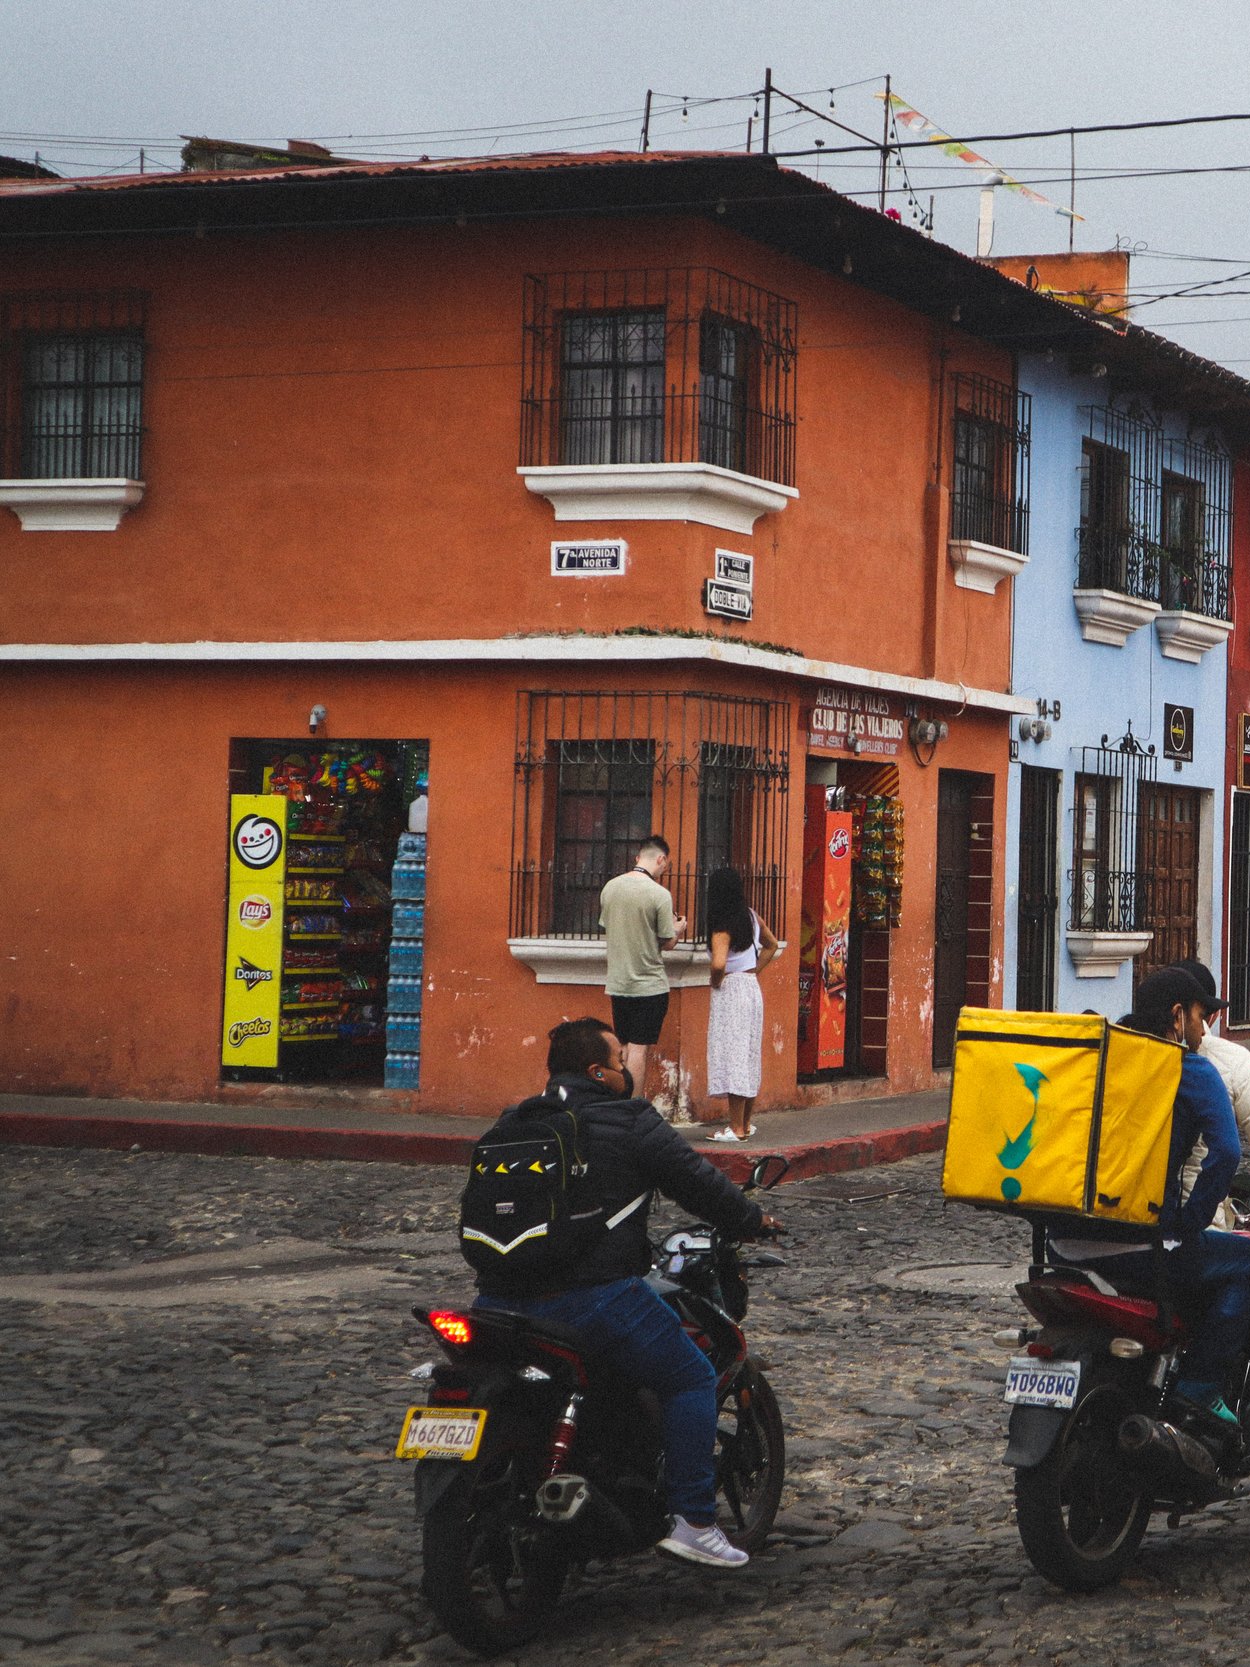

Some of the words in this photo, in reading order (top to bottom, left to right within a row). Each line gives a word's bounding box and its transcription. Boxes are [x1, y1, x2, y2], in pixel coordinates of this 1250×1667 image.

[578, 548, 617, 558] AVENIDA
[583, 558, 612, 567] NORTE
[732, 559, 746, 570] CALLE
[727, 568, 750, 582] PONIENTE
[714, 590, 735, 607] DOBLE
[816, 687, 849, 709] AGENCIA
[851, 691, 861, 711] DE
[865, 694, 890, 715] VIAJES
[1036, 697, 1061, 722] 14-B
[812, 708, 835, 732] CLUB
[836, 711, 847, 733] DE
[849, 713, 866, 735] LOS
[867, 714, 904, 740] VIAJEROS
[236, 968, 272, 980] Doritos
[229, 1018, 271, 1045] Cheetos
[406, 1424, 477, 1445] M667GZD
